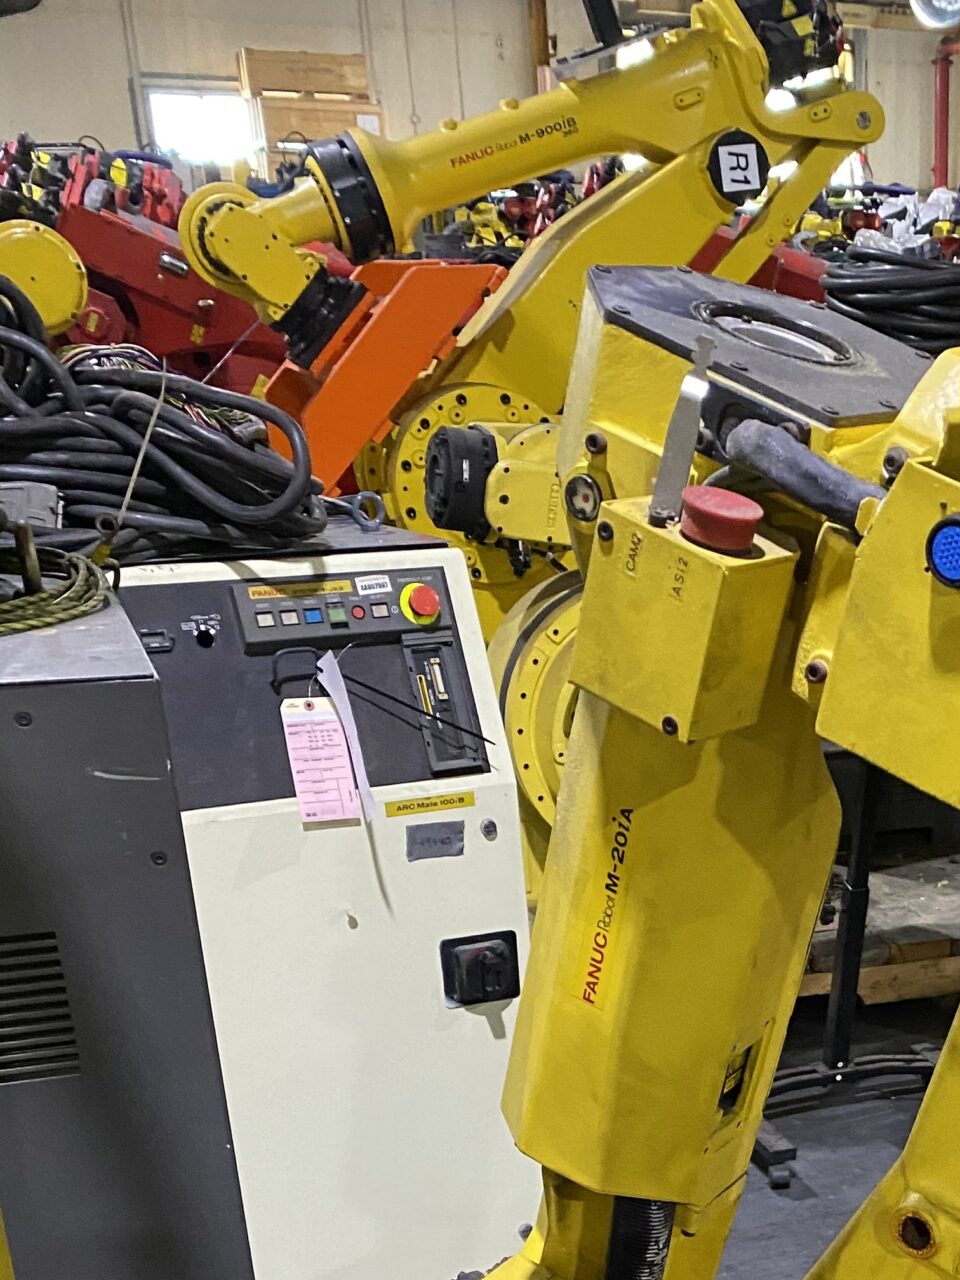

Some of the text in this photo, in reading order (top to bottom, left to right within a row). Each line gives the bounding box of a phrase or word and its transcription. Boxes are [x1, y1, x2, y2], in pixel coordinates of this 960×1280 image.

[450, 145, 494, 168] FANUC
[518, 115, 577, 145] M-900iB
[727, 151, 752, 185] R1
[626, 532, 643, 572] CAM2
[396, 803, 416, 812] ARC
[416, 799, 439, 809] Mate
[583, 808, 635, 1005] FANUC Robot M-20iA
